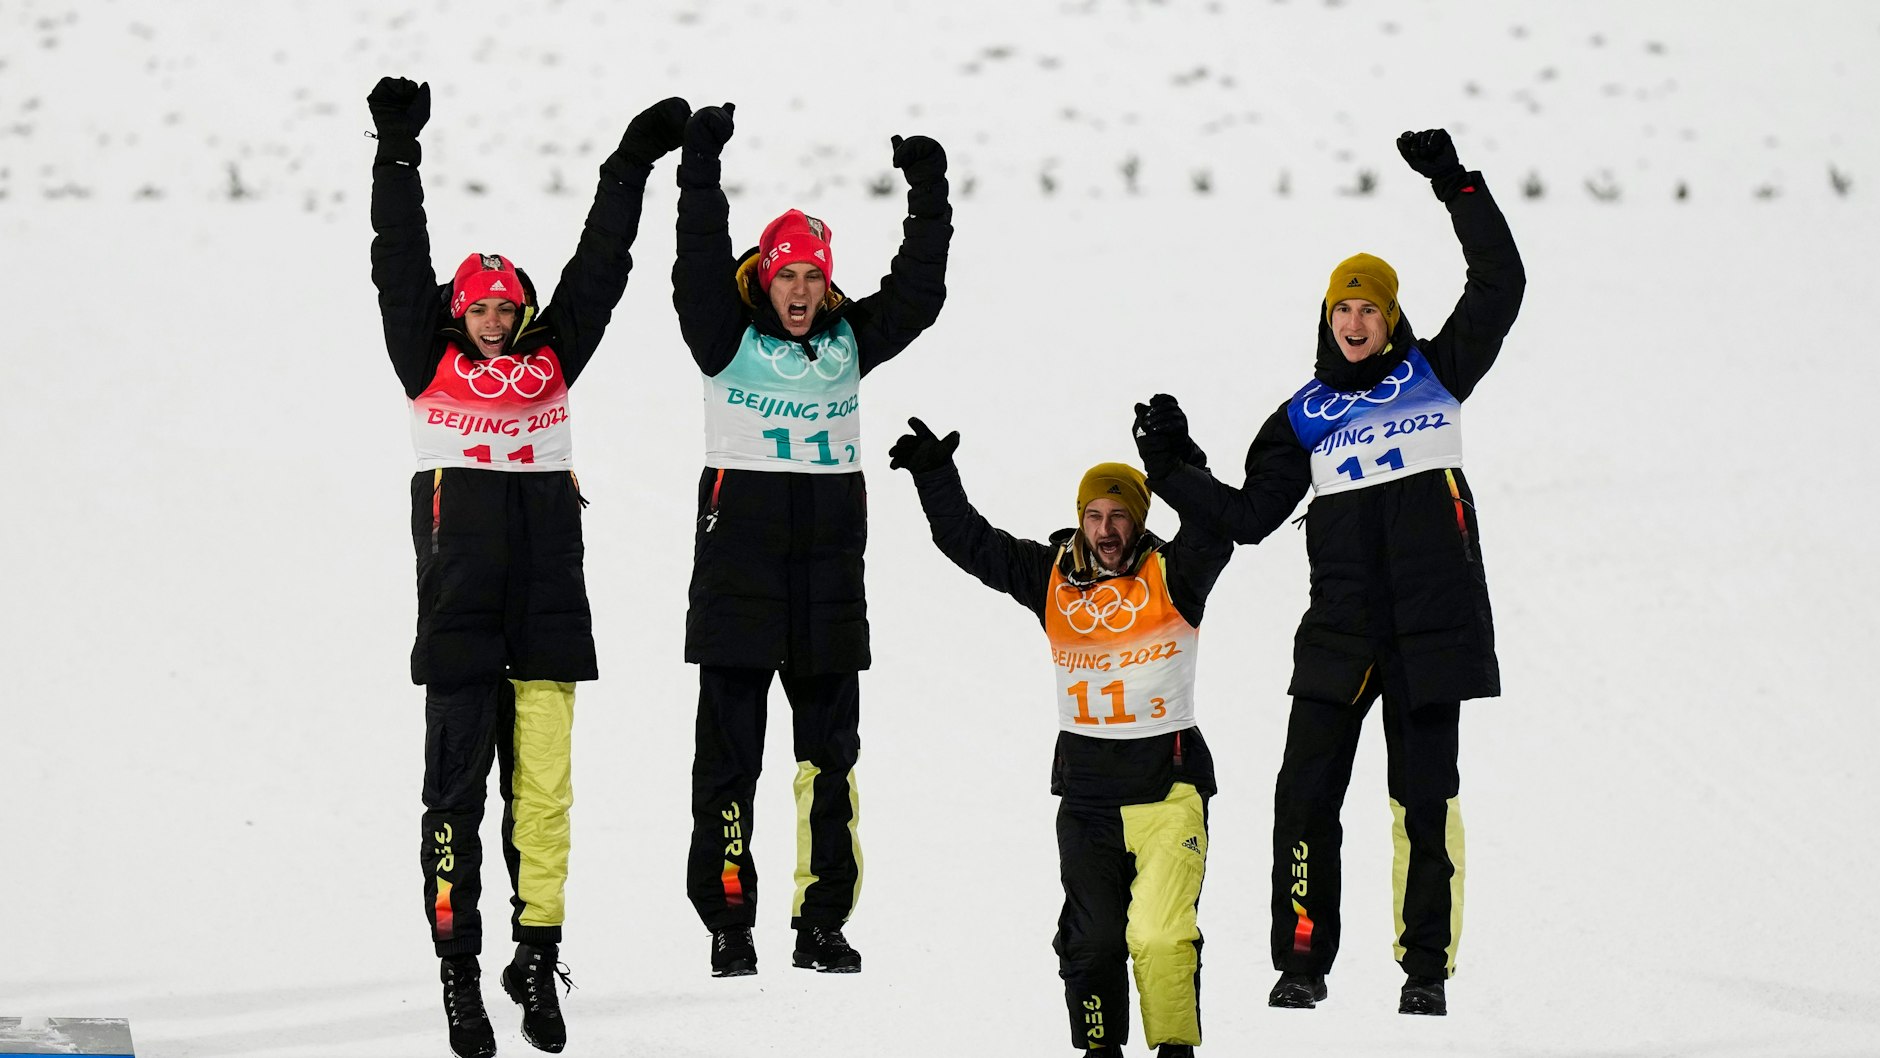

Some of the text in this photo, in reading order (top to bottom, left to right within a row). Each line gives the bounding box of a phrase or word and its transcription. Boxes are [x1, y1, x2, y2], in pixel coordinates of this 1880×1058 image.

[763, 242, 791, 269] GER
[427, 406, 568, 436] BEIJING 2022
[727, 387, 859, 421] BEIJING 2022
[762, 427, 840, 465] 11
[1314, 412, 1452, 457] EIJING 2022
[1119, 640, 1183, 667] 2022
[1067, 680, 1167, 725] 11 3
[435, 822, 454, 872] GER
[722, 801, 743, 856] GER
[1291, 841, 1309, 897] GER
[1083, 994, 1104, 1039] GER
